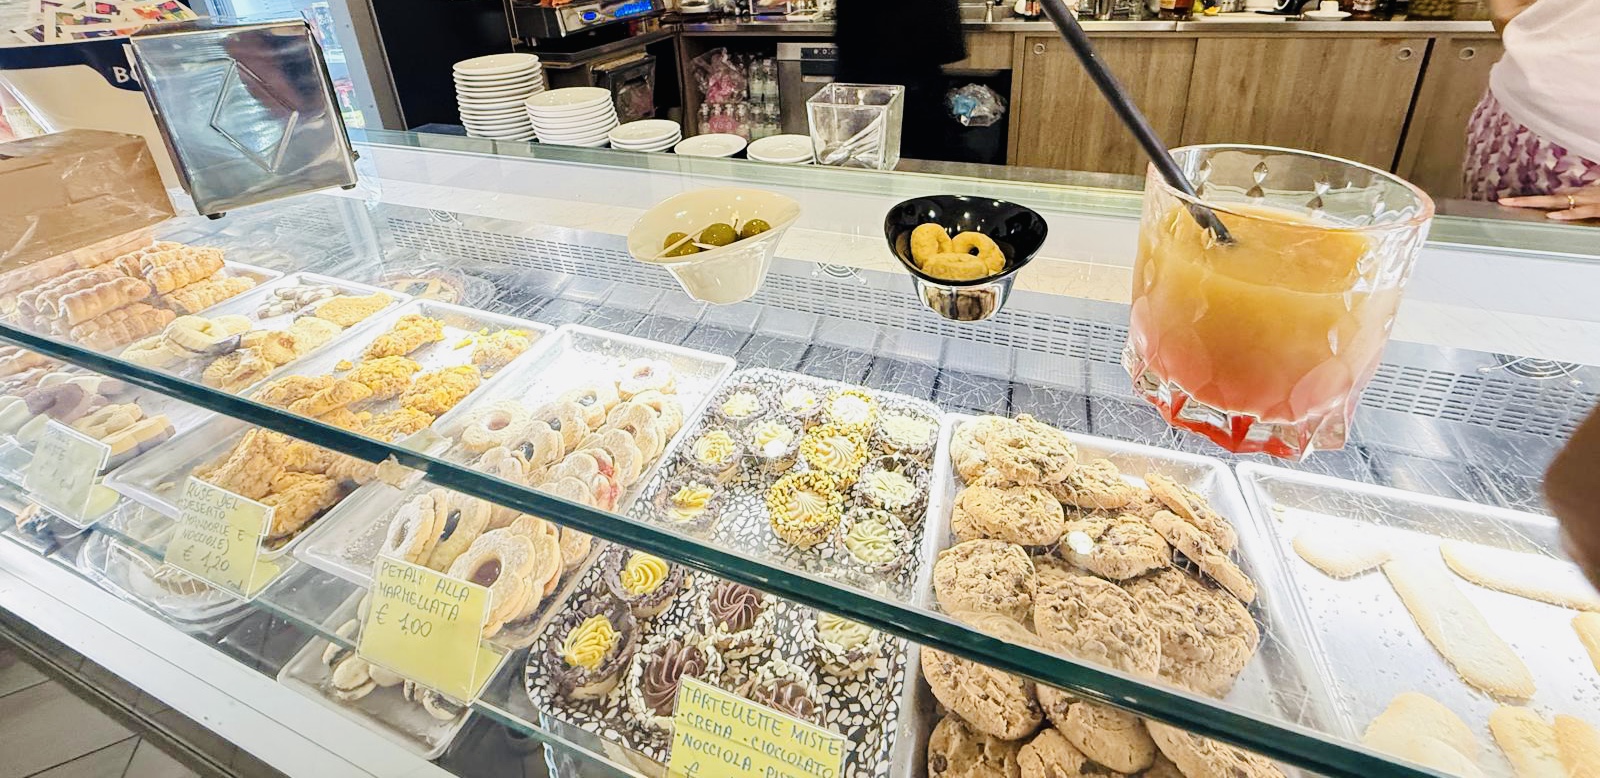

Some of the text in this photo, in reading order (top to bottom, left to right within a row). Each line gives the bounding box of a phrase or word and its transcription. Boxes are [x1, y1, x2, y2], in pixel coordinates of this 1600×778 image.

[237, 529, 245, 542] E
[183, 544, 231, 573] € 1,20
[381, 561, 470, 603] PETALI ALLA
[375, 603, 389, 625] €
[379, 582, 460, 622] MARMELLATA
[682, 684, 839, 756] TARTELLETTE MISTE
